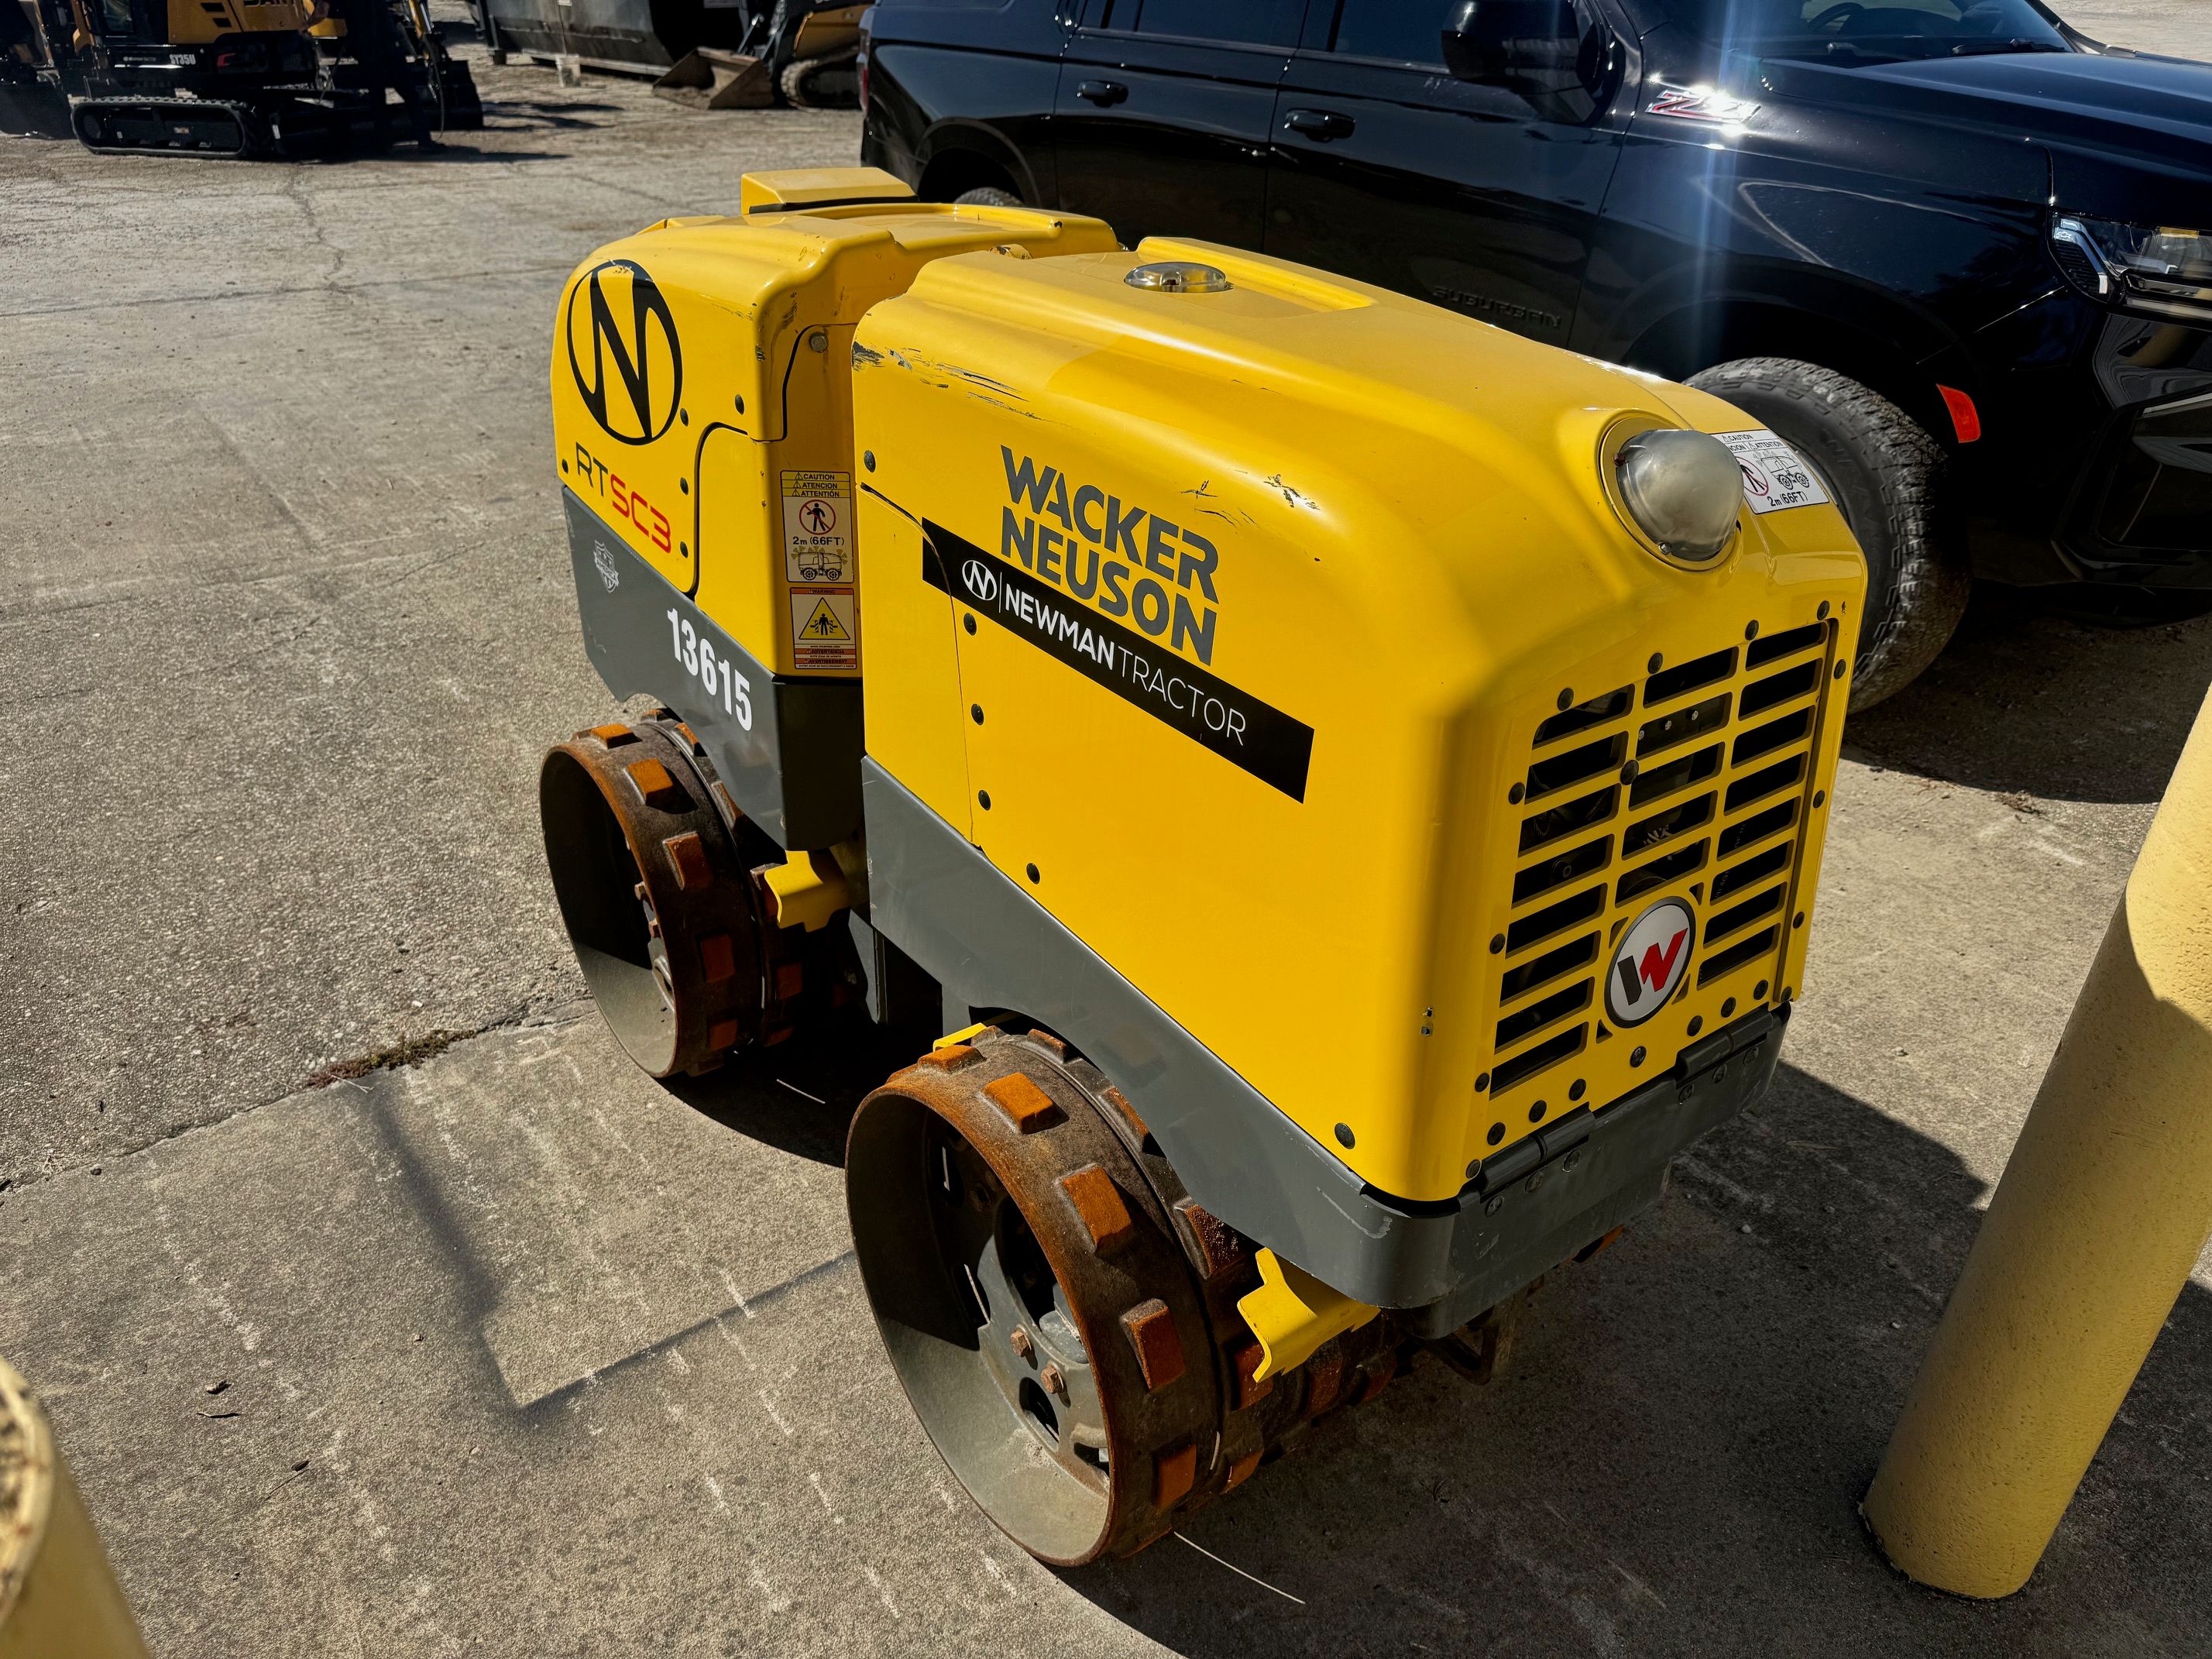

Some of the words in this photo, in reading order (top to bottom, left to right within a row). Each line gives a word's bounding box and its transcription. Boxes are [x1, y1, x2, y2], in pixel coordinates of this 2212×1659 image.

[169, 53, 196, 65] SY35U
[1432, 285, 1562, 328] SUBURBAN
[1000, 445, 1220, 605] WACKER
[1001, 506, 1218, 667] NEUSON
[666, 607, 753, 732] 13615
